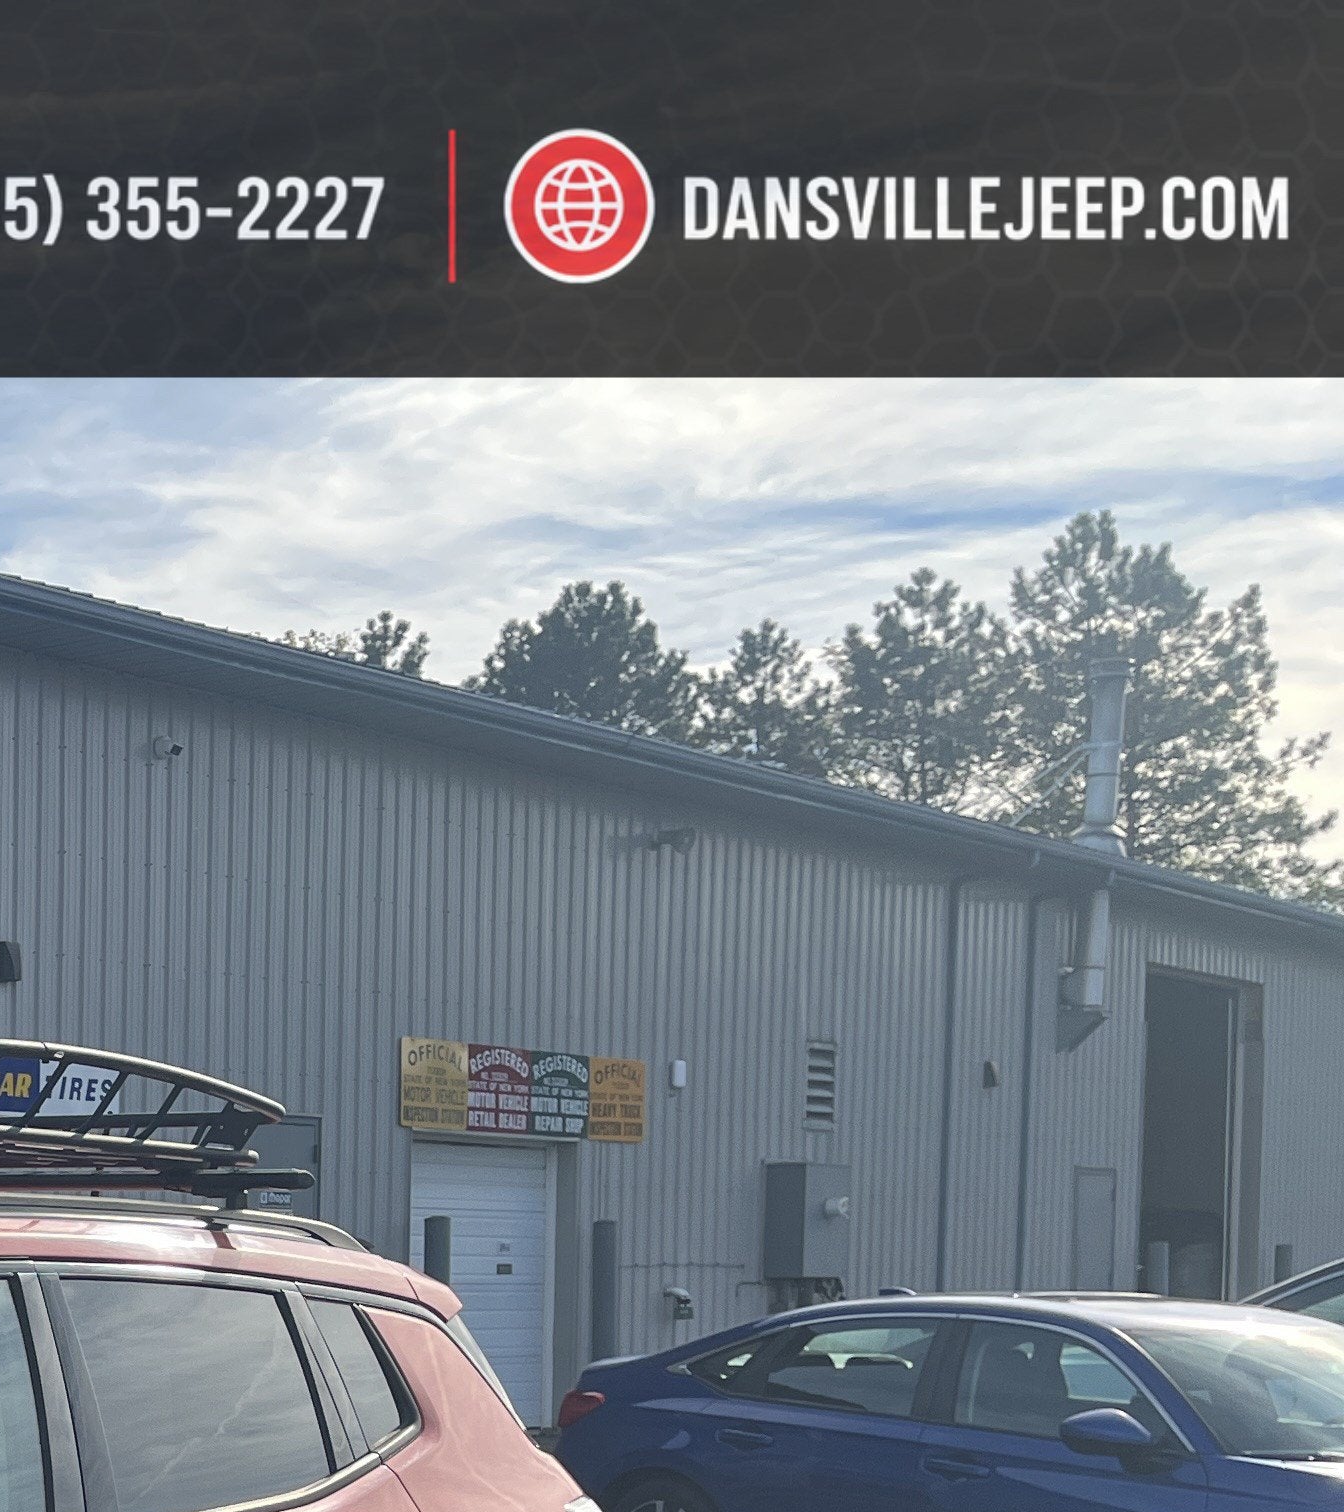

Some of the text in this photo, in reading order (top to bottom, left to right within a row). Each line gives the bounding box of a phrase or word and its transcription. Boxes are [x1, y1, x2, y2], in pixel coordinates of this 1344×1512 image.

[408, 1043, 463, 1072] OFFICIAL
[470, 1048, 529, 1078] REGISTERED
[532, 1055, 589, 1083] REGISTERED
[46, 1076, 114, 1101] IRES
